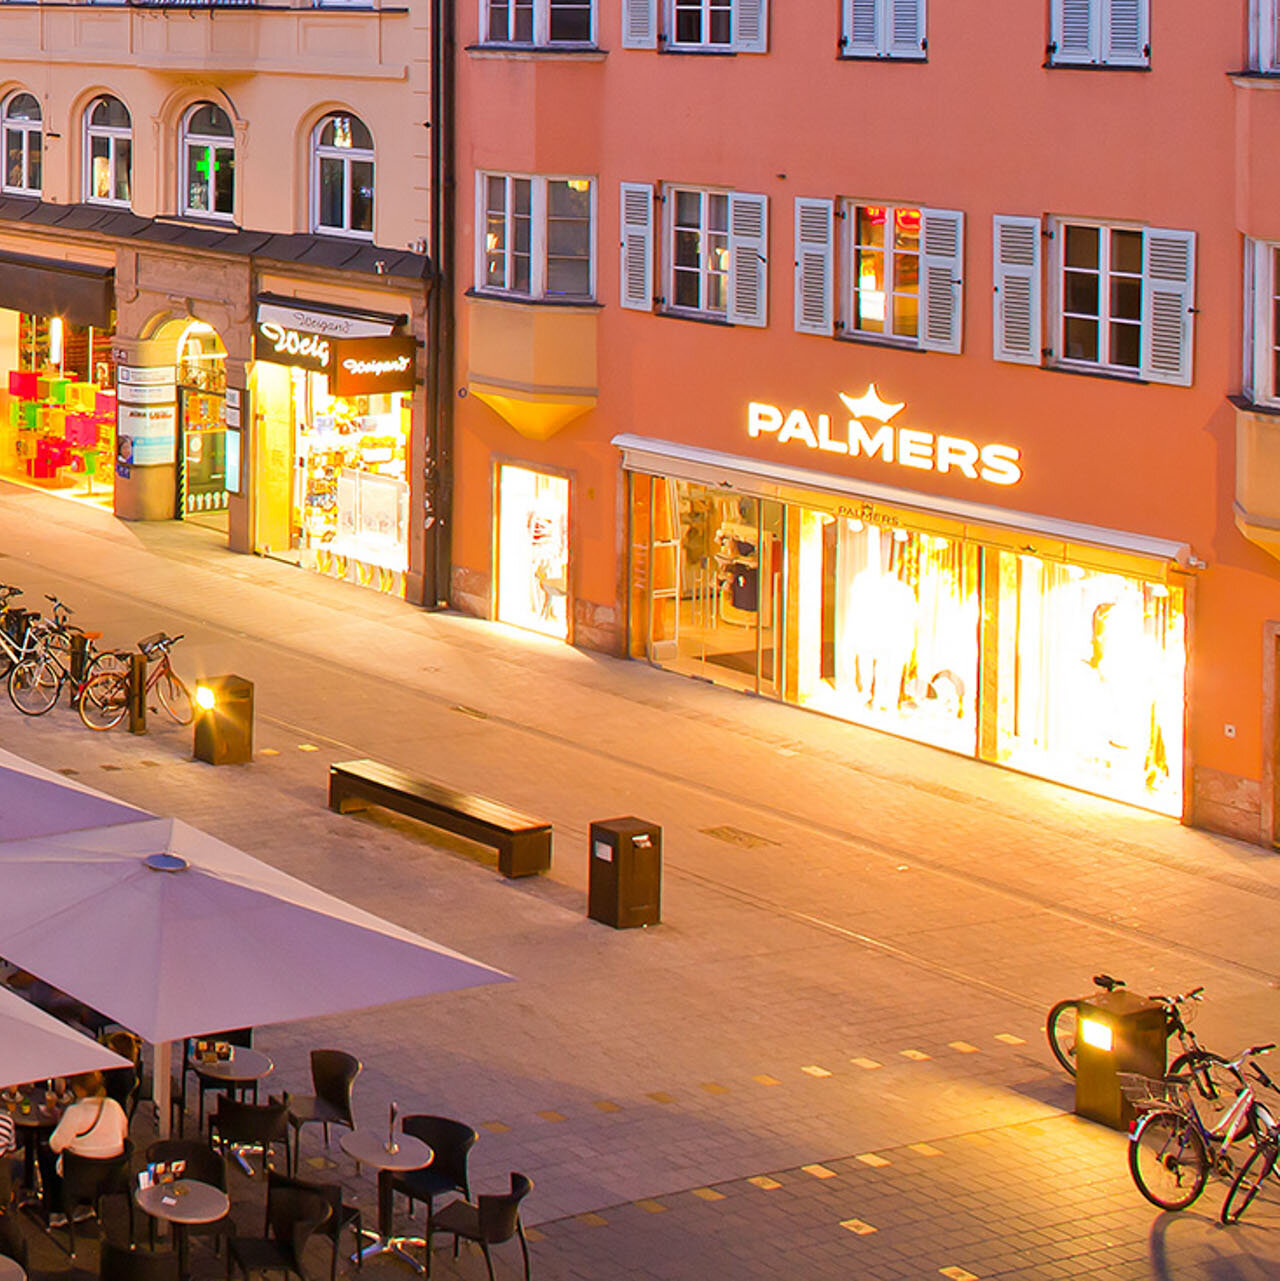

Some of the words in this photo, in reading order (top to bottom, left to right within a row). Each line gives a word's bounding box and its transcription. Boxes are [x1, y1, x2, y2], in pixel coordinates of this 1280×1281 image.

[292, 311, 353, 334] Weigand
[260, 322, 330, 367] Weig
[343, 356, 410, 376] Weigand
[748, 401, 1023, 486] PALMERS
[839, 506, 899, 526] PALMERS
